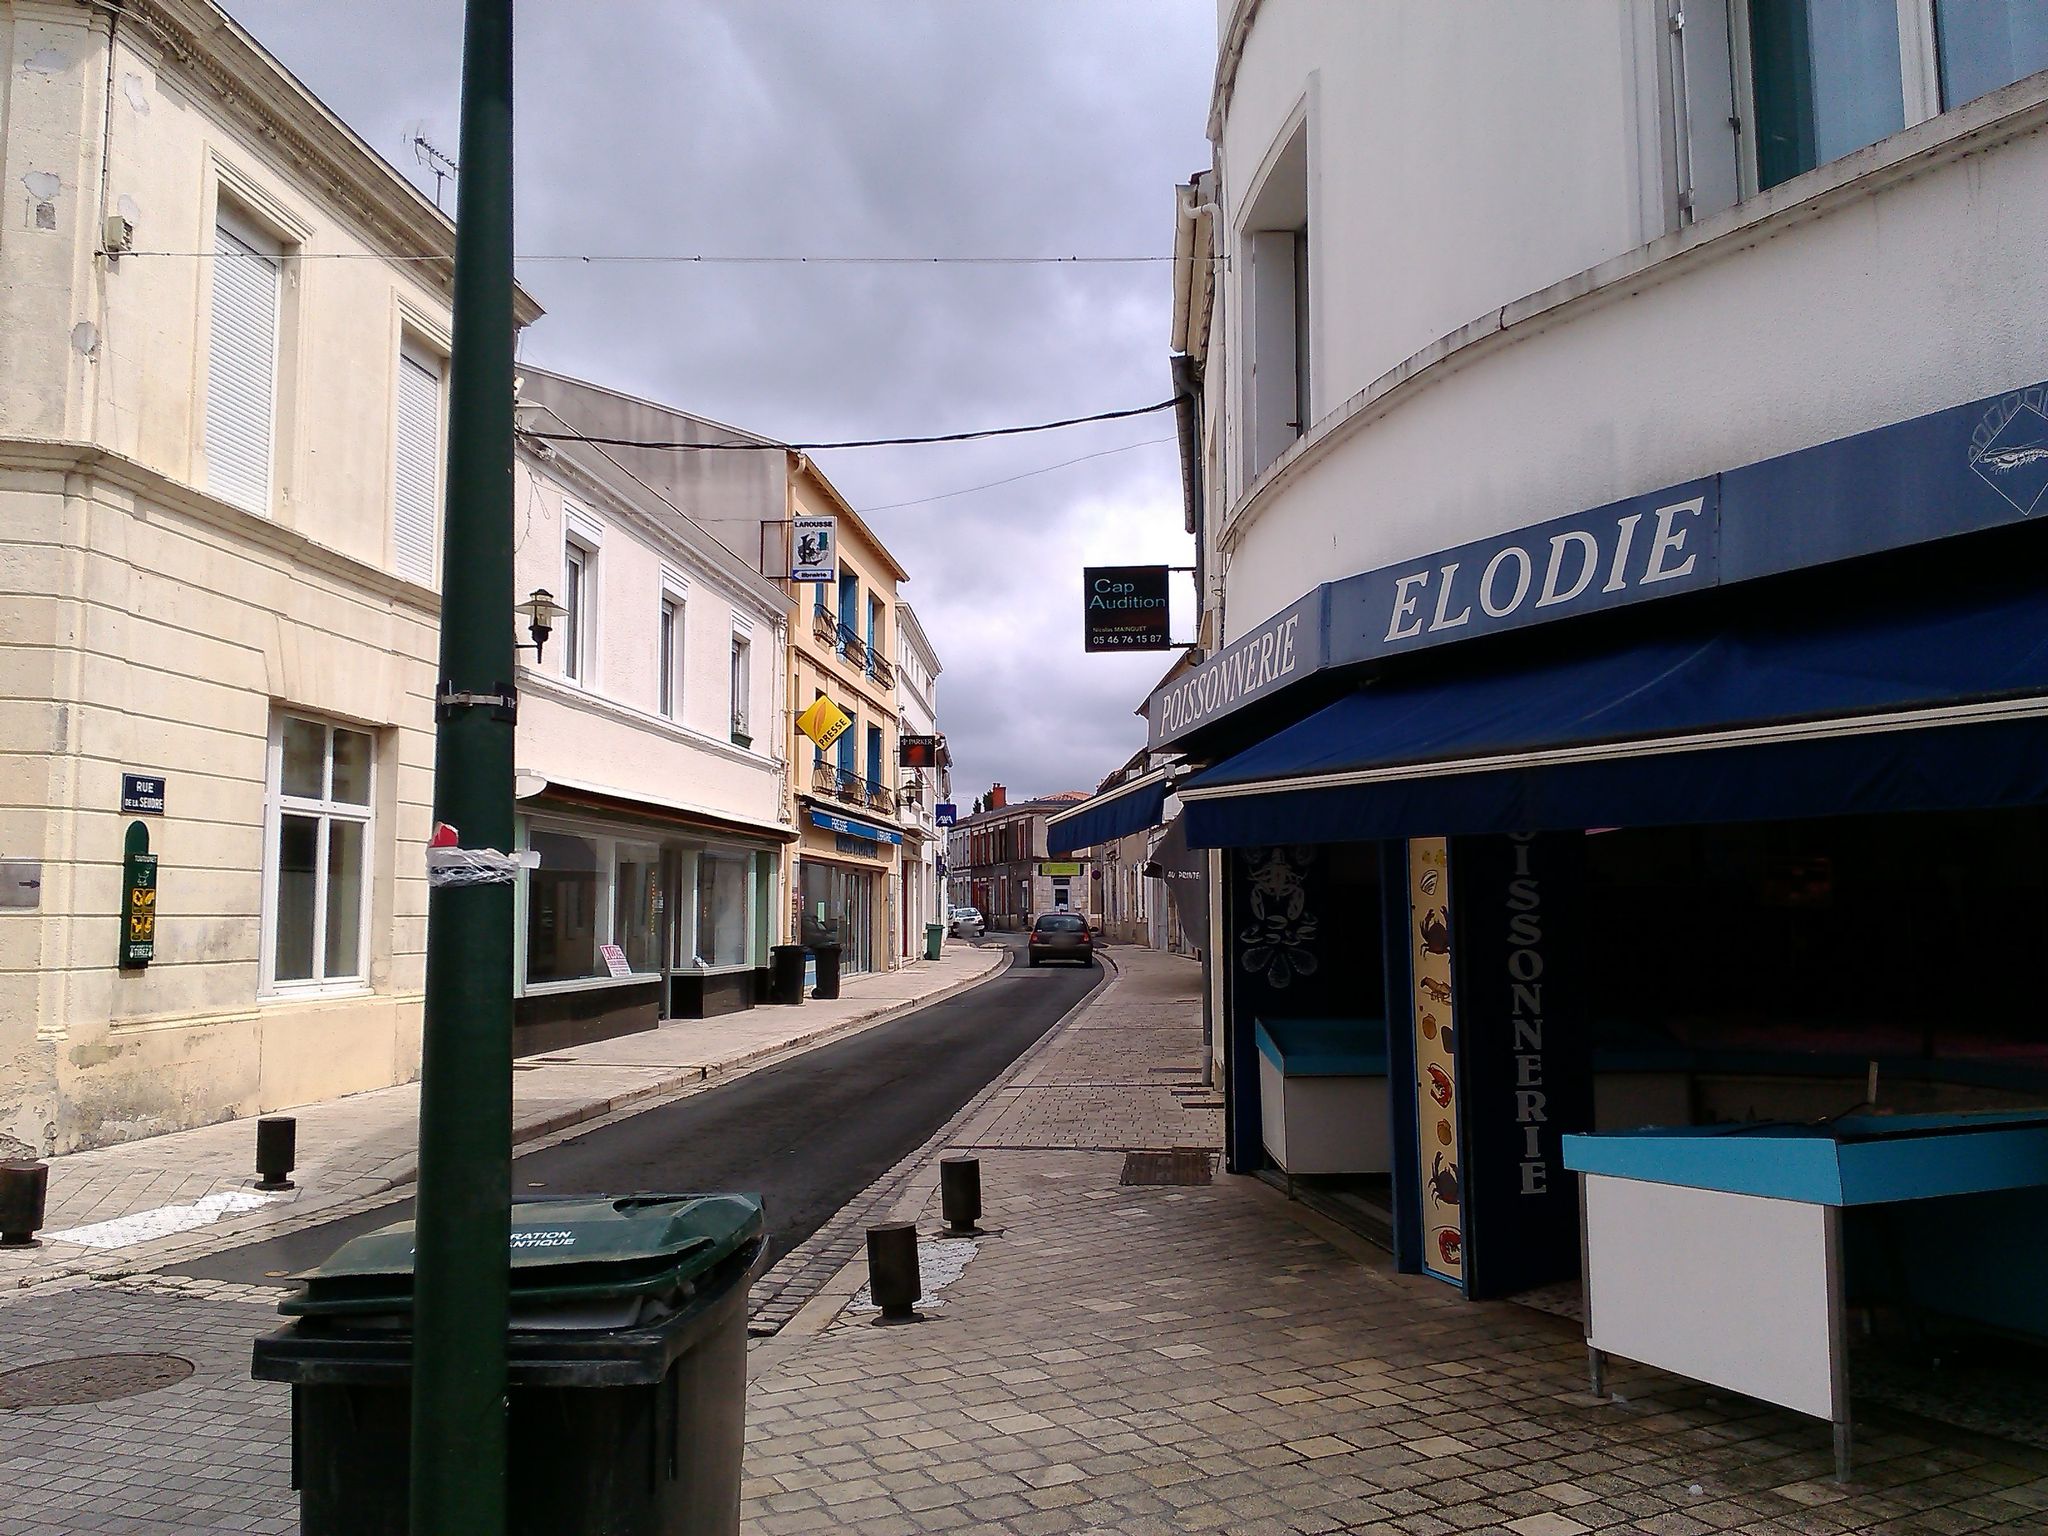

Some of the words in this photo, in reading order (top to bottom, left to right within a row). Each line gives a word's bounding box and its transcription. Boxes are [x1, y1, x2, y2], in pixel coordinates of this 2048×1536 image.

[1384, 495, 1705, 643] ELODIE
[1094, 578, 1135, 595] Cap
[1089, 594, 1166, 609] Audition
[1093, 635, 1105, 645] 05
[1107, 635, 1120, 644] 46
[1121, 635, 1134, 643] 76
[1136, 634, 1148, 643] 15
[1150, 634, 1162, 643] 87
[1159, 613, 1299, 738] POISSONNERIE
[818, 718, 847, 747] PRESSE
[136, 781, 154, 793] RUE
[125, 798, 132, 807] DE
[132, 799, 139, 807] LA
[831, 817, 848, 832] PRESSE
[936, 815, 954, 824] AXA
[1507, 832, 1548, 1195] ISSONNERIE
[510, 1230, 572, 1240] RATION
[510, 1238, 577, 1248] NTIQUE
